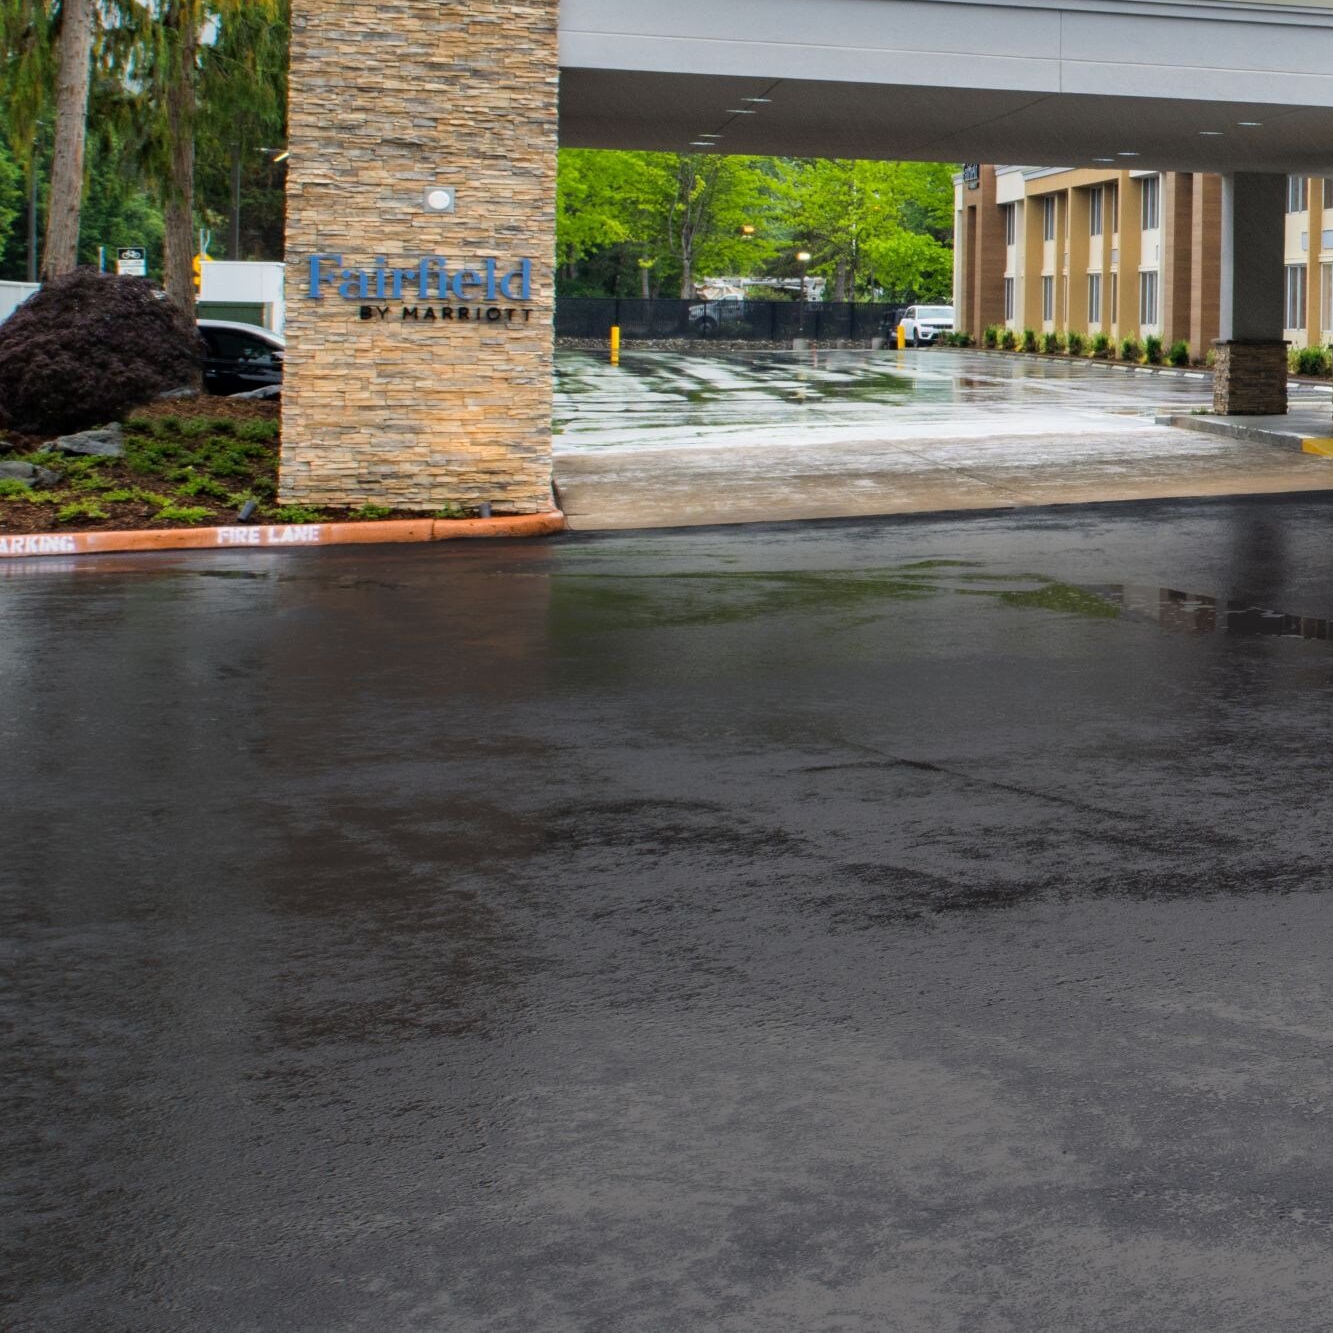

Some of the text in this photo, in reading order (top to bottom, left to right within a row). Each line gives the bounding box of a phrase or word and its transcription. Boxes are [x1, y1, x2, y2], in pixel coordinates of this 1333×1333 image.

[306, 254, 532, 301] Fairfield
[360, 305, 533, 322] BY MARRIOTT
[217, 527, 260, 544] FIRE
[268, 525, 320, 543] LANE
